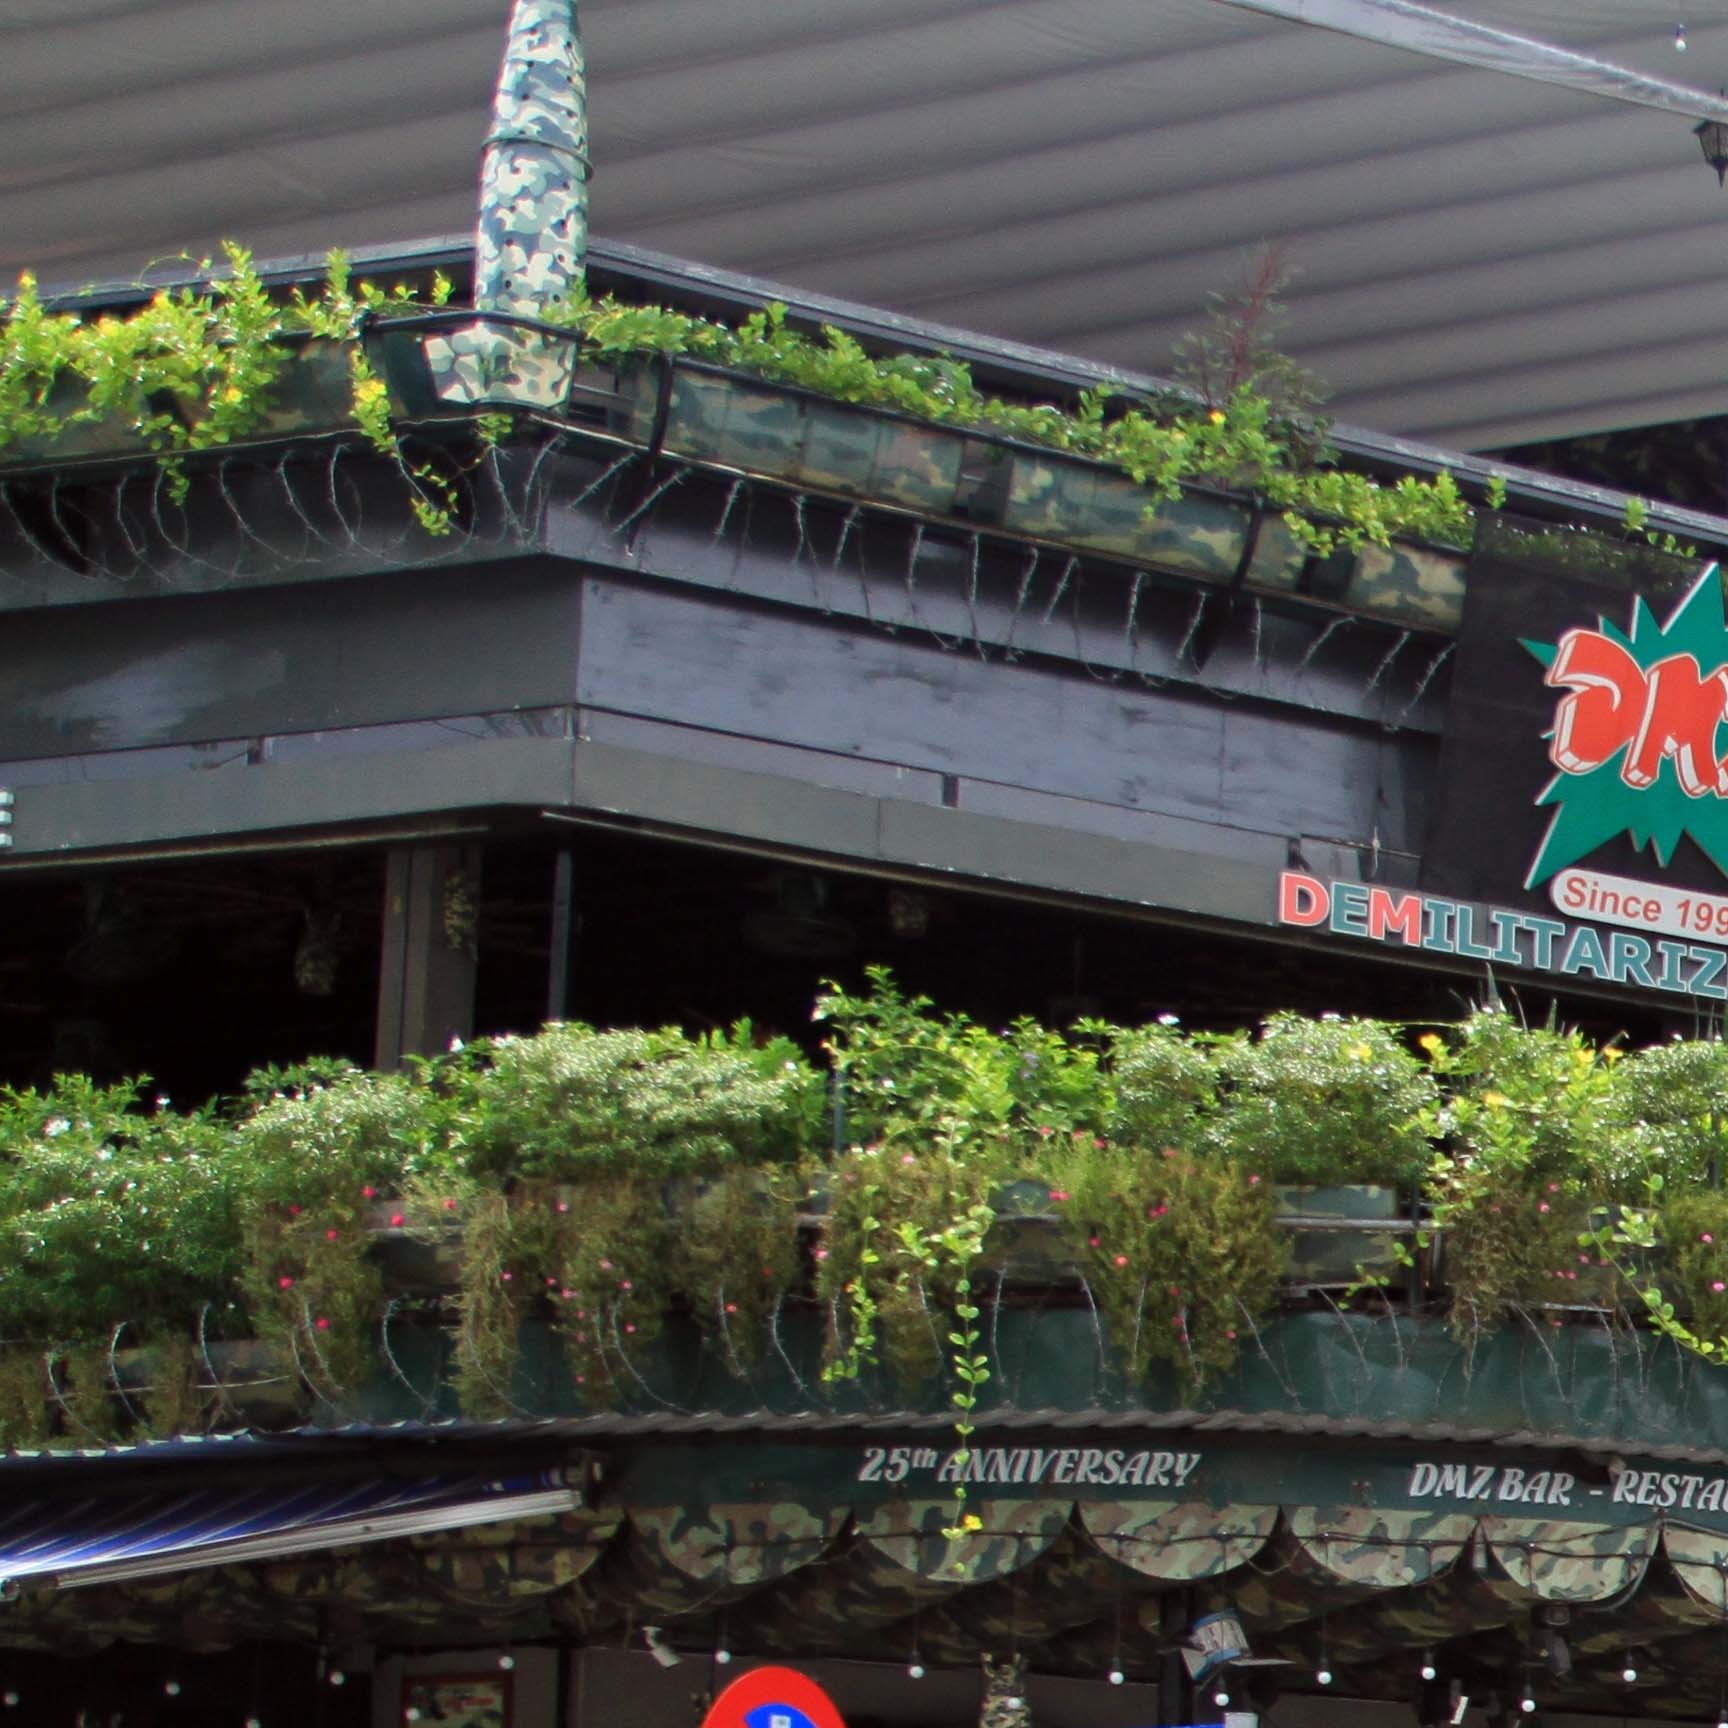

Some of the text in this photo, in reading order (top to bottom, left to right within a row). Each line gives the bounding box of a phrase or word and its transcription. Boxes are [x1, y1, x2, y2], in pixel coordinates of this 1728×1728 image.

[1562, 875, 1662, 922] Since
[858, 1447, 1201, 1488] 25th ANNIVERSARY
[1409, 1462, 1494, 1500] DMZ
[1498, 1470, 1575, 1506] BAR
